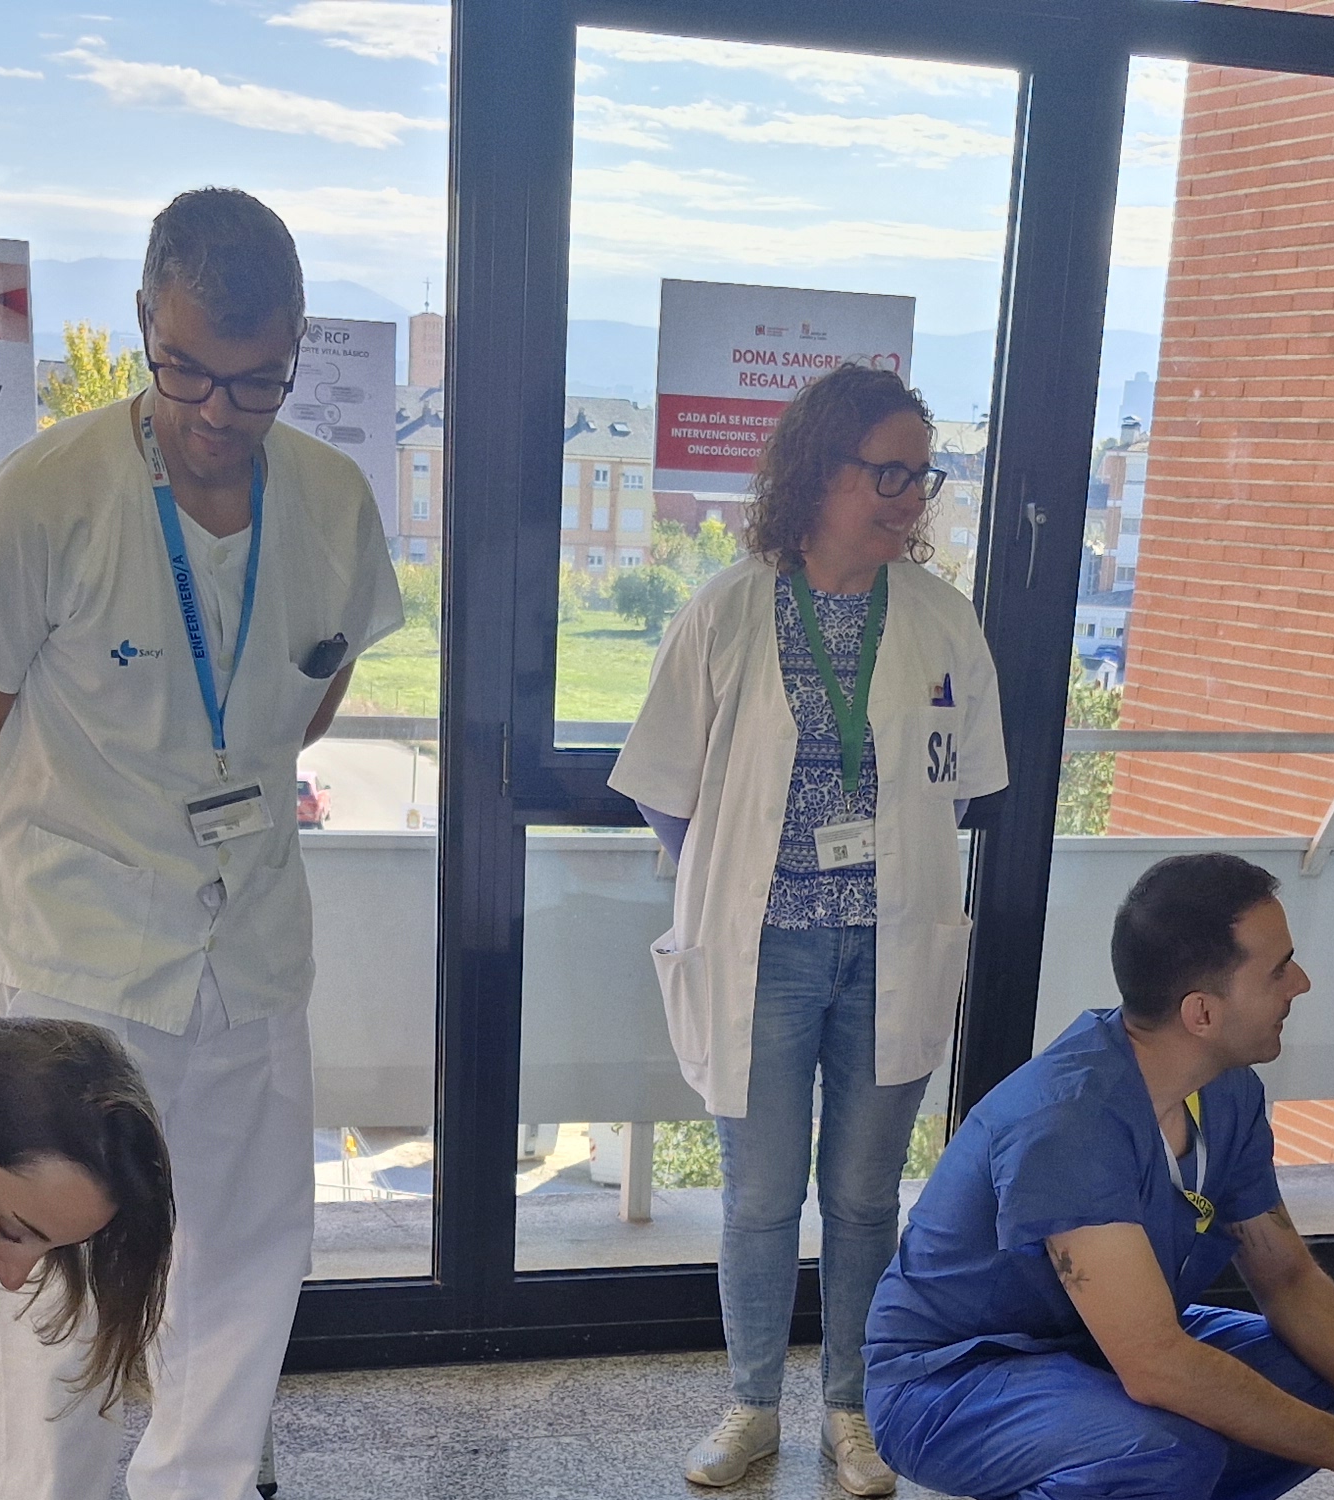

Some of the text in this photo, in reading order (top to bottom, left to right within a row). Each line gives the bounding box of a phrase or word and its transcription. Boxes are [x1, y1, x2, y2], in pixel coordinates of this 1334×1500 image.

[324, 331, 350, 344] RCP
[300, 346, 319, 355] ORTE
[322, 348, 341, 356] VITAL
[732, 348, 778, 366] DONA
[739, 371, 798, 389] REGALA
[678, 412, 707, 423] CADA
[709, 411, 727, 424] DÍA
[729, 415, 740, 425] SE
[671, 428, 759, 443] INTERVENCIONES,
[687, 443, 762, 458] ONCOLÓGICOS
[172, 554, 205, 659] ENFERMERO/A
[139, 648, 163, 659] Sacyl
